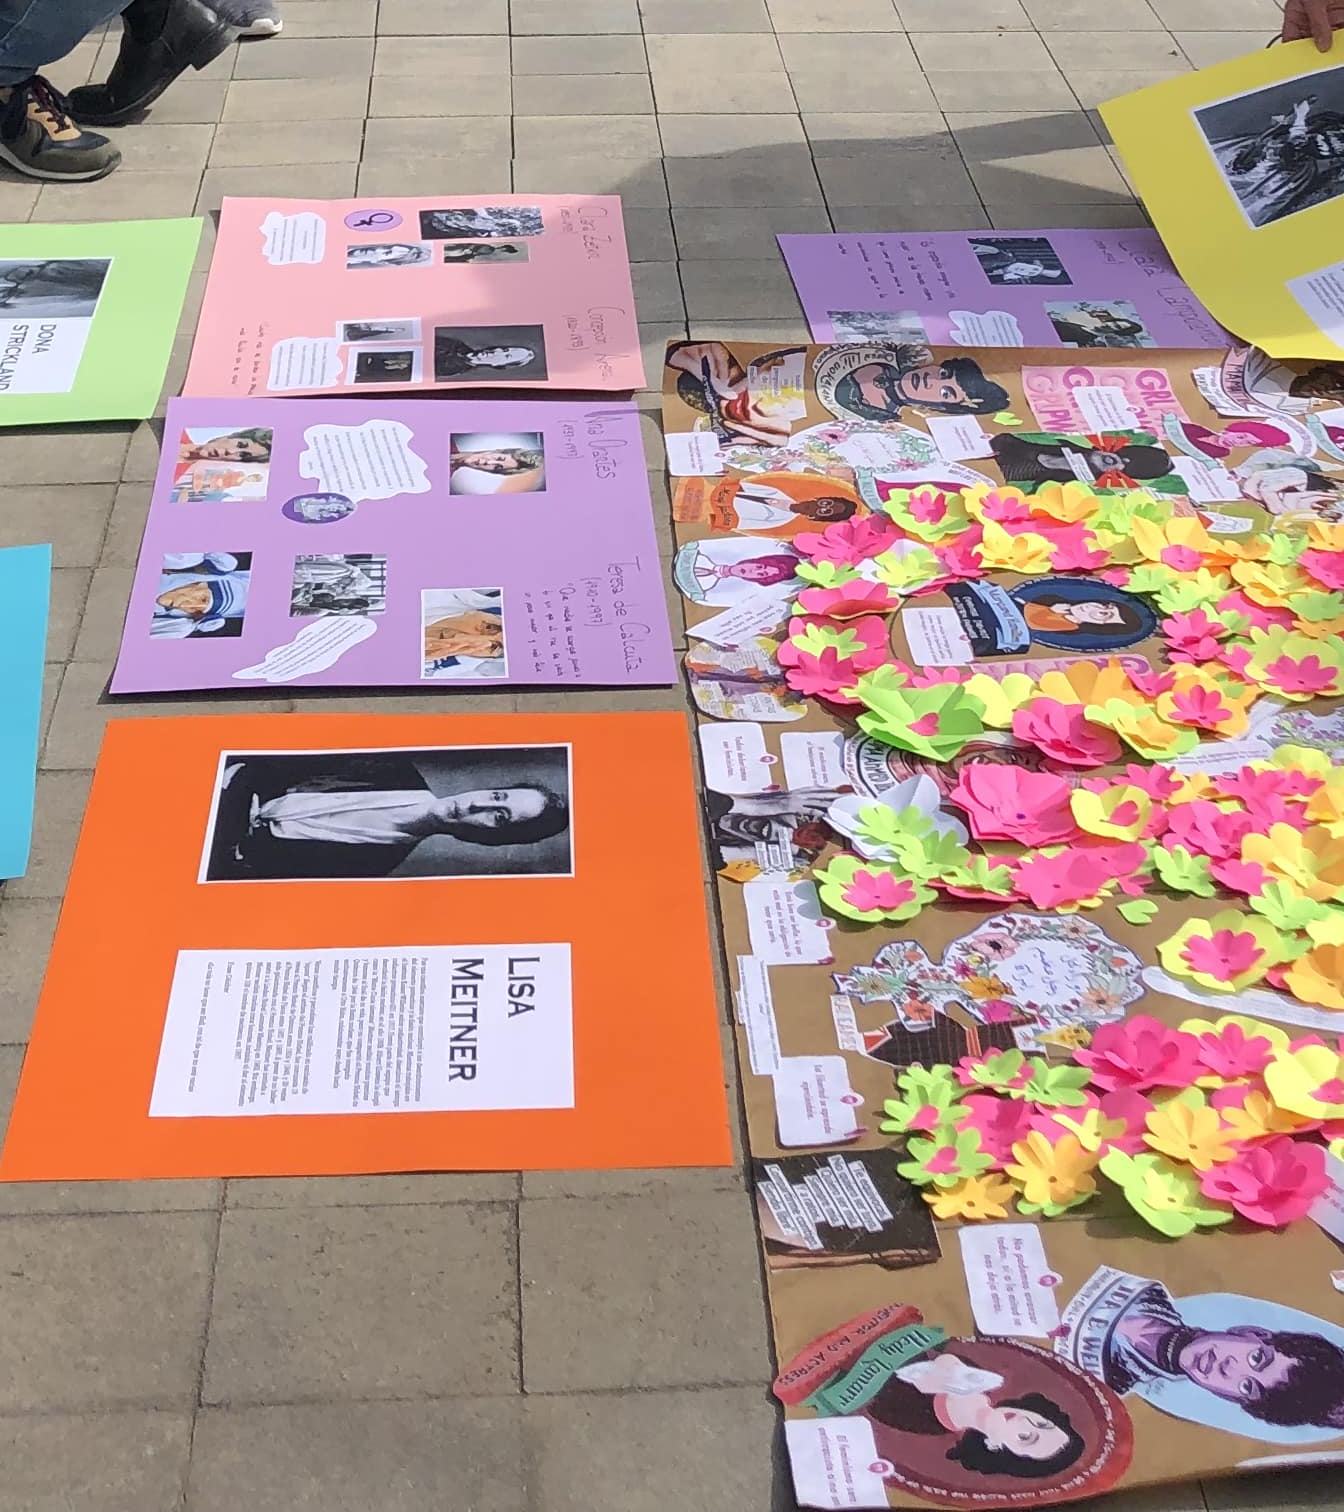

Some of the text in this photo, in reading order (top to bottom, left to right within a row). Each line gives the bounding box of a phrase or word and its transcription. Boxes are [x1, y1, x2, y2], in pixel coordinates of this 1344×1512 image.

[31, 324, 57, 354] DONA
[608, 555, 640, 594] Teresa
[1100, 1284, 1138, 1308] IDA
[1090, 1314, 1112, 1329] B.
[777, 1351, 826, 1386] ACTRESS
[838, 1329, 934, 1408] Hedy Lamarr
